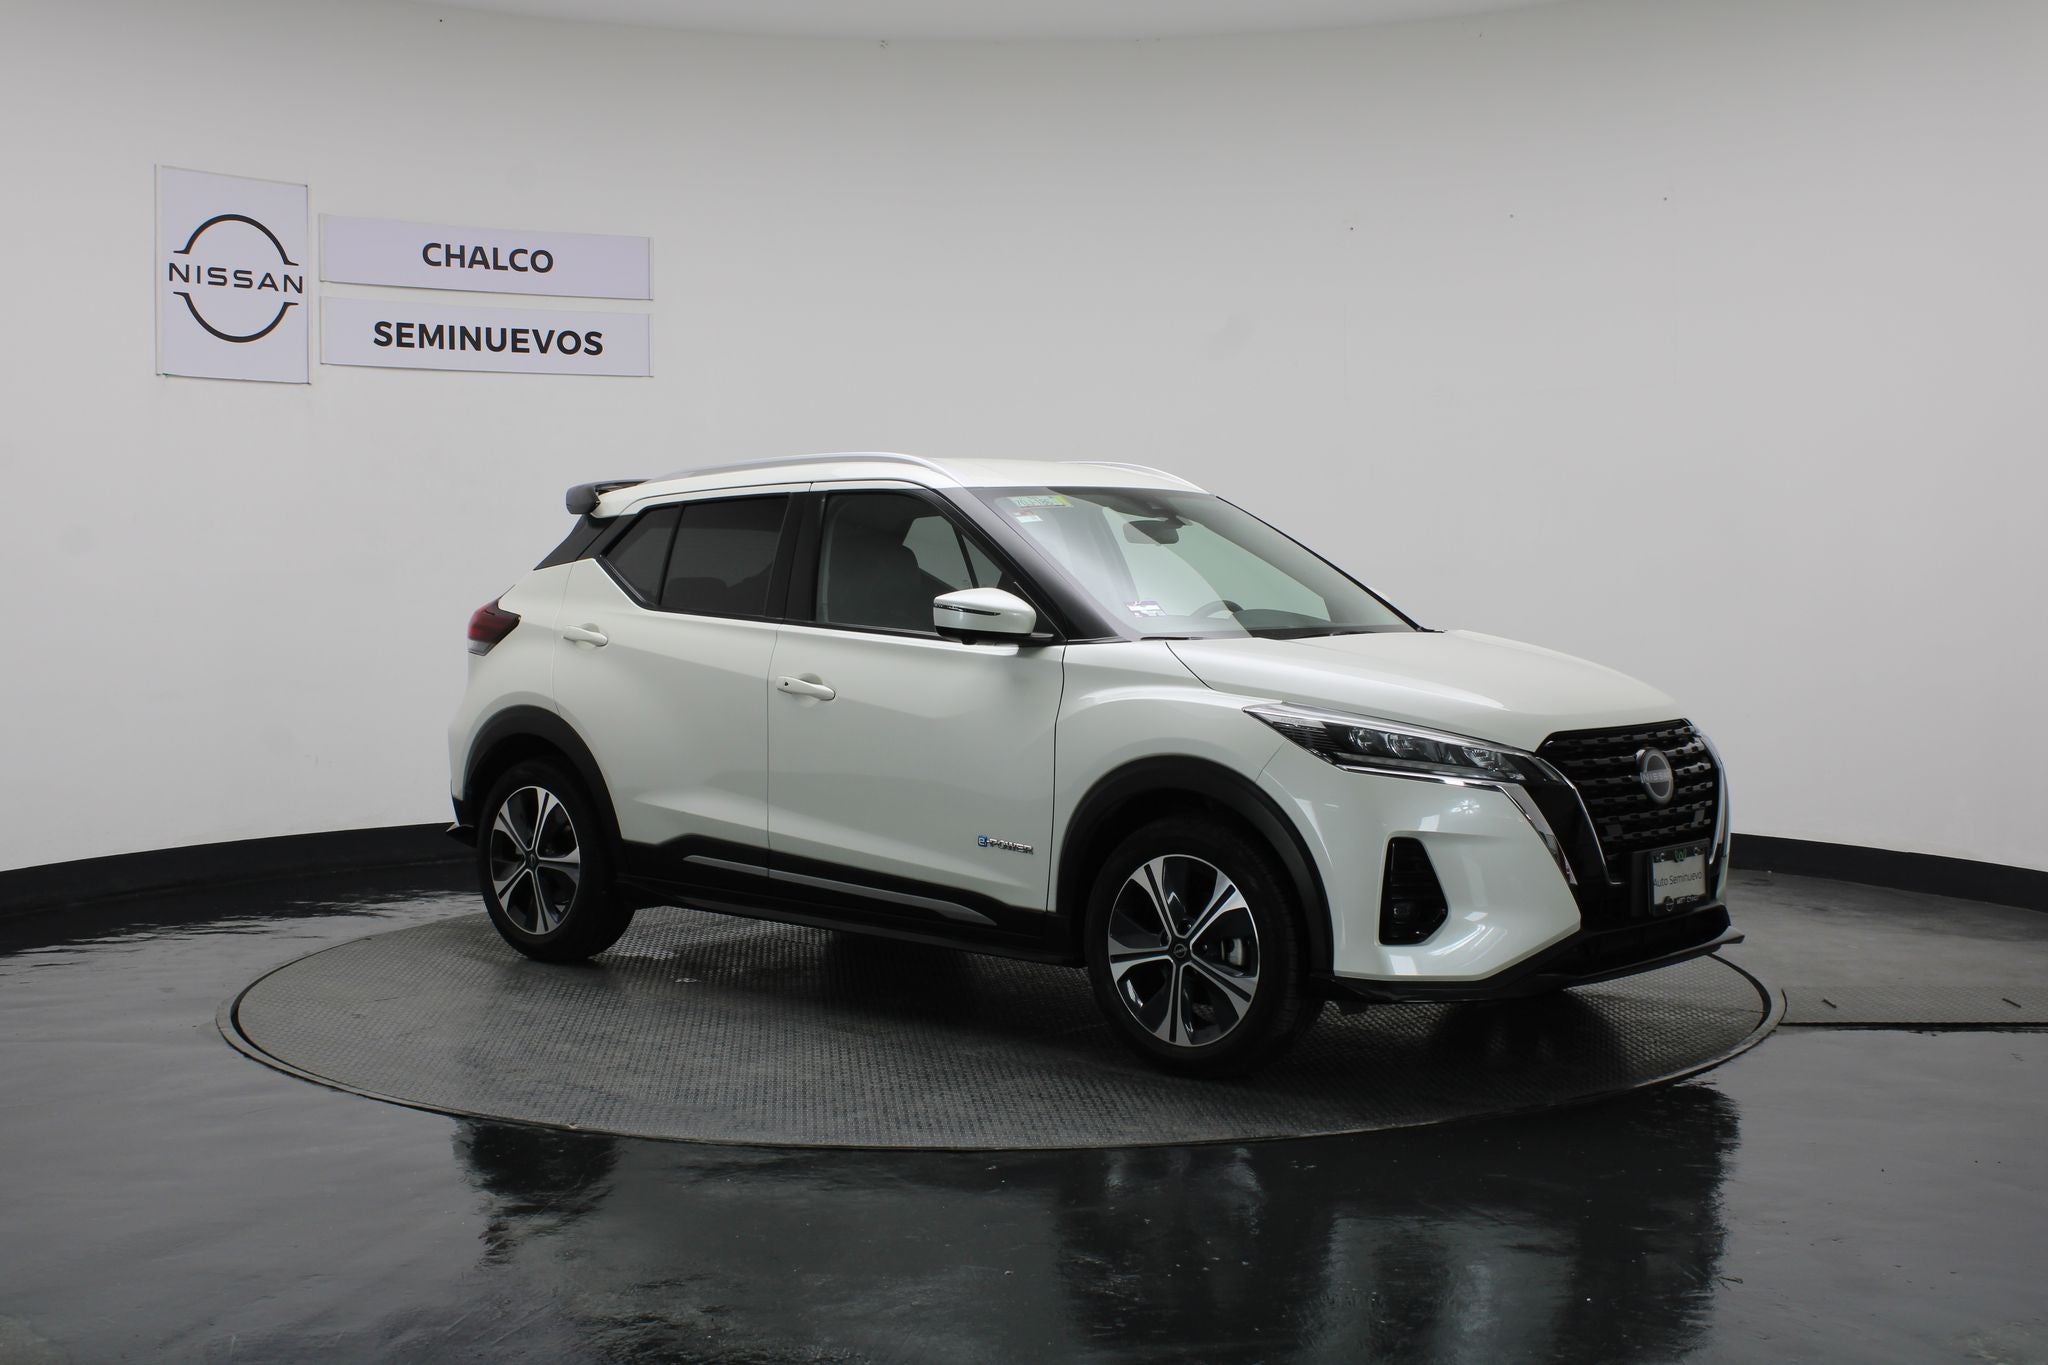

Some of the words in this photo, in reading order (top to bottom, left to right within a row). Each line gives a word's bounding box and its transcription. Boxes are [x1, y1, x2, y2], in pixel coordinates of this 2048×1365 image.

[422, 242, 554, 273] CHALCO
[169, 262, 303, 294] NISSAN
[373, 321, 604, 356] SEMINUEVOS
